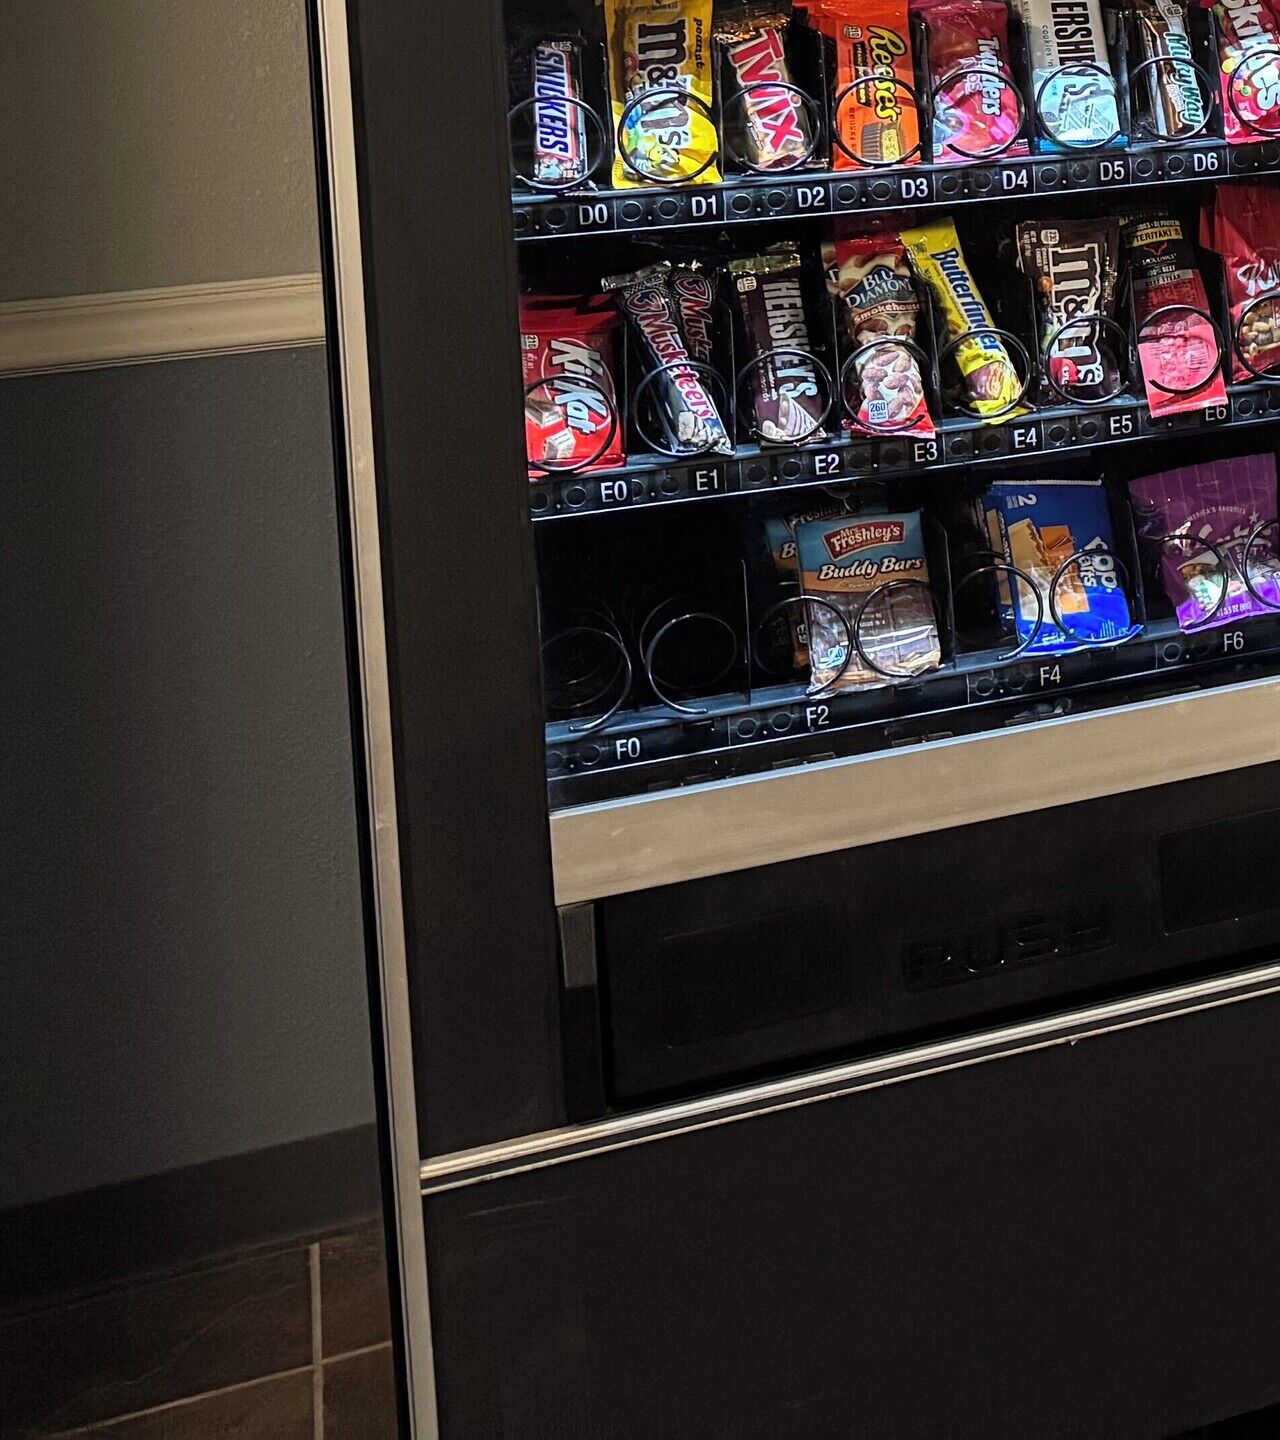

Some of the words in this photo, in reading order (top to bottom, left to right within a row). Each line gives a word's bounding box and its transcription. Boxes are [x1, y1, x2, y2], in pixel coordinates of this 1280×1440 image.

[693, 15, 705, 71] peanut
[535, 46, 570, 154] SNICKERS
[1100, 161, 1125, 180] D5
[1194, 153, 1219, 172] D6
[902, 178, 928, 199] D3
[1003, 171, 1028, 190] D4
[692, 196, 718, 217] D1
[798, 187, 826, 208] D2
[579, 205, 609, 226] D0
[1135, 229, 1172, 243] TERIYAKI
[863, 271, 895, 292] BLU
[628, 290, 663, 314] 3
[638, 311, 716, 421] Musketeers
[870, 401, 887, 414] 260
[1205, 403, 1228, 422] E6
[1110, 415, 1132, 436] E5
[1014, 428, 1038, 449] E4
[914, 442, 938, 463] E3
[815, 455, 839, 476] E2
[601, 480, 627, 503] E0
[696, 471, 718, 492] E1
[831, 524, 901, 552] Freshley's
[819, 561, 880, 581] Buddy
[881, 556, 924, 573] Bars
[1223, 632, 1244, 652] F6
[1040, 665, 1061, 686] F4
[806, 706, 830, 727] F2
[616, 738, 641, 760] F0
